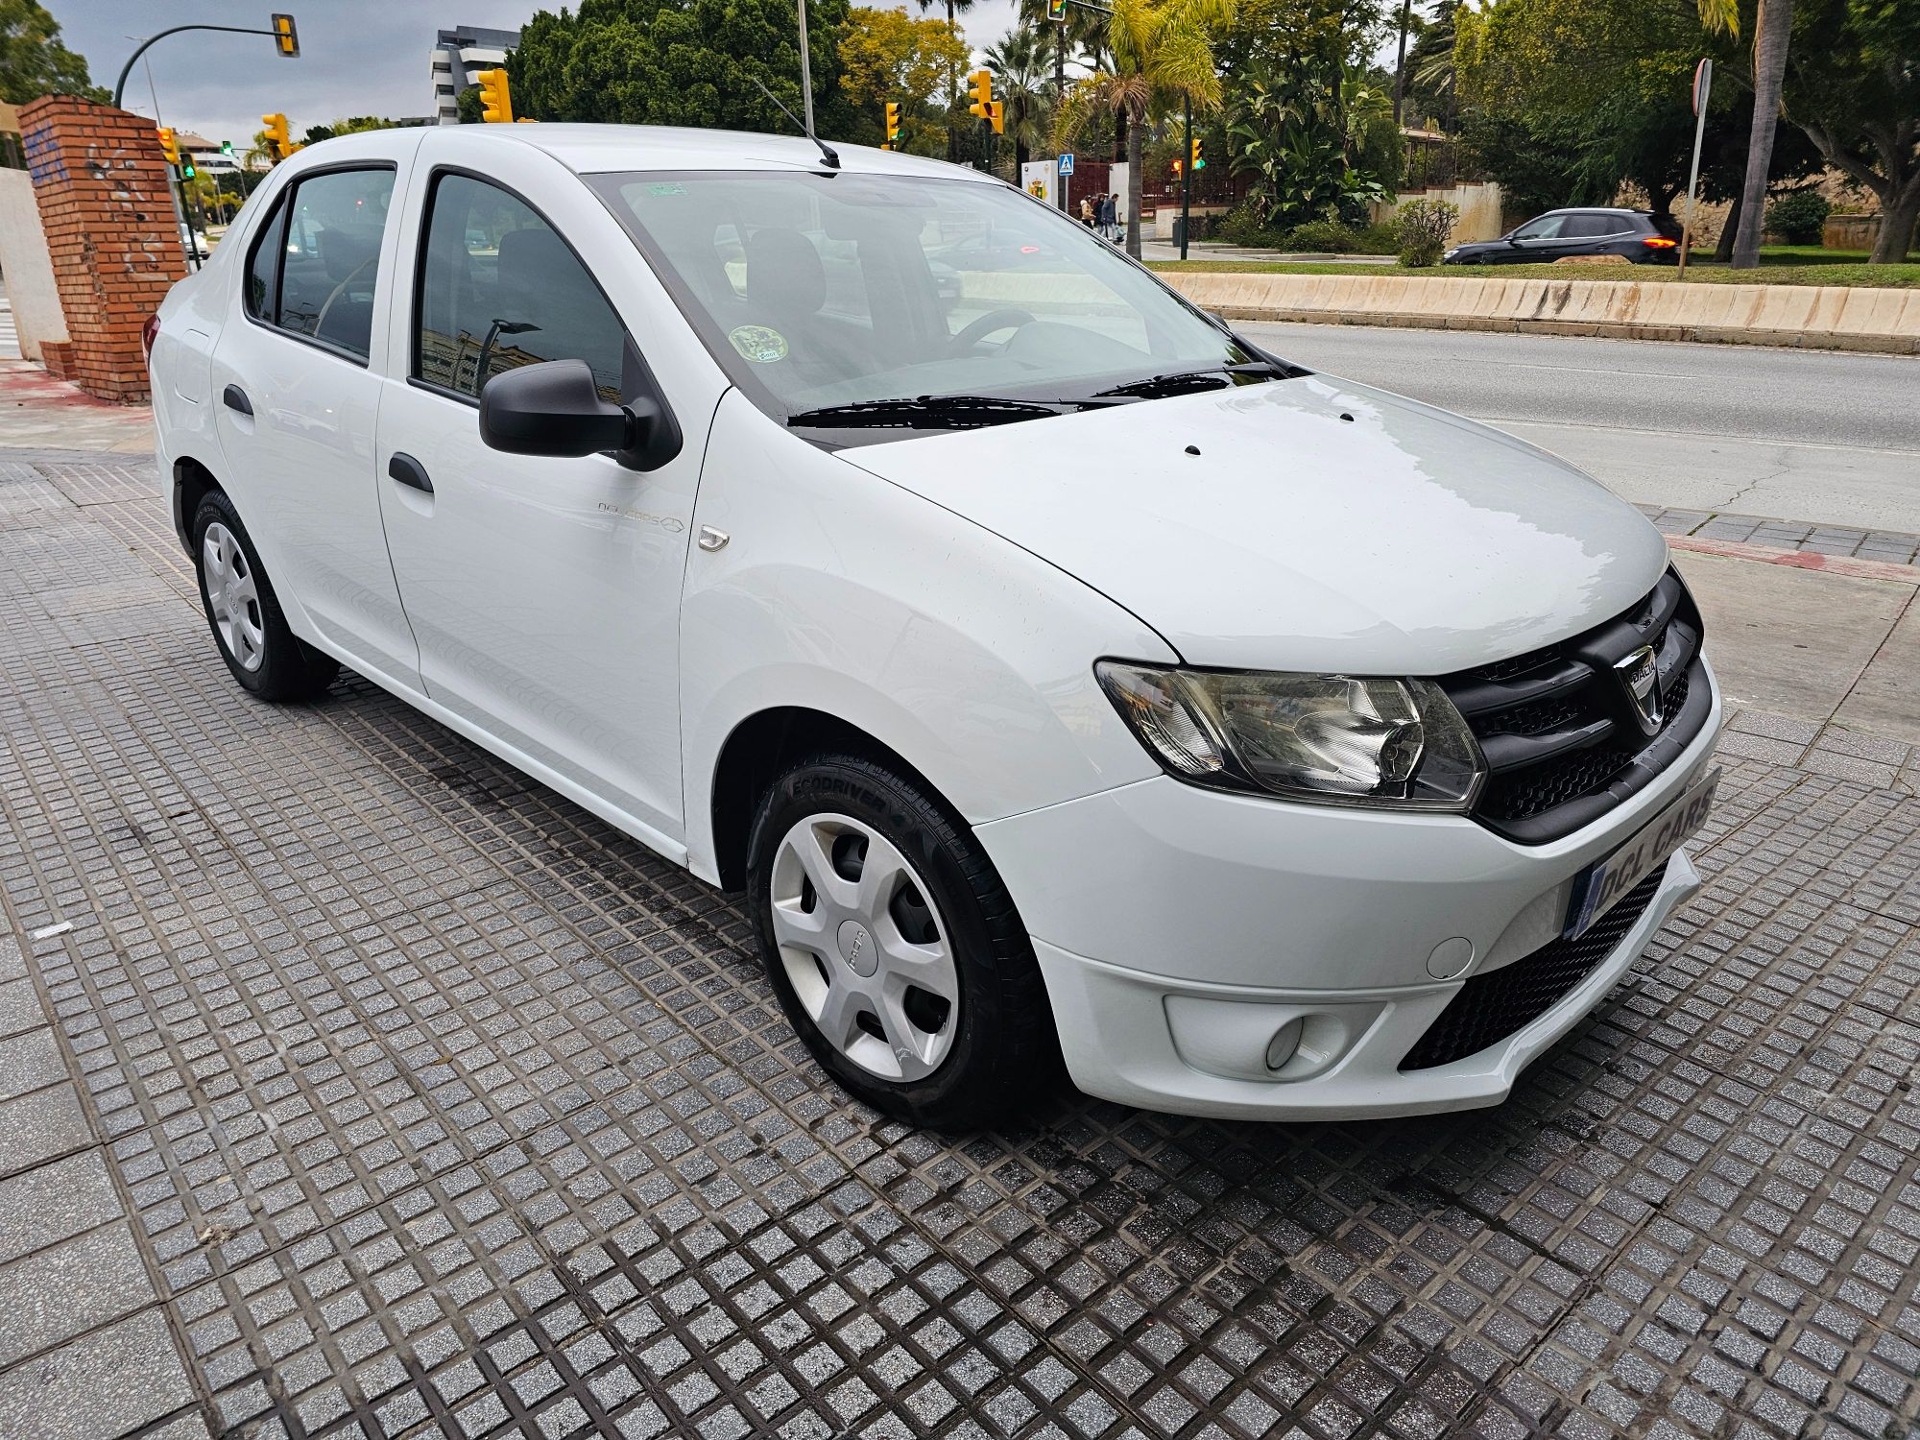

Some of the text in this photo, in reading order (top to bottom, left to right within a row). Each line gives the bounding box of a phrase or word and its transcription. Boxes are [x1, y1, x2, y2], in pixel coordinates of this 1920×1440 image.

[1630, 661, 1656, 685] DACIA
[1594, 785, 1715, 914] DCL CARS
